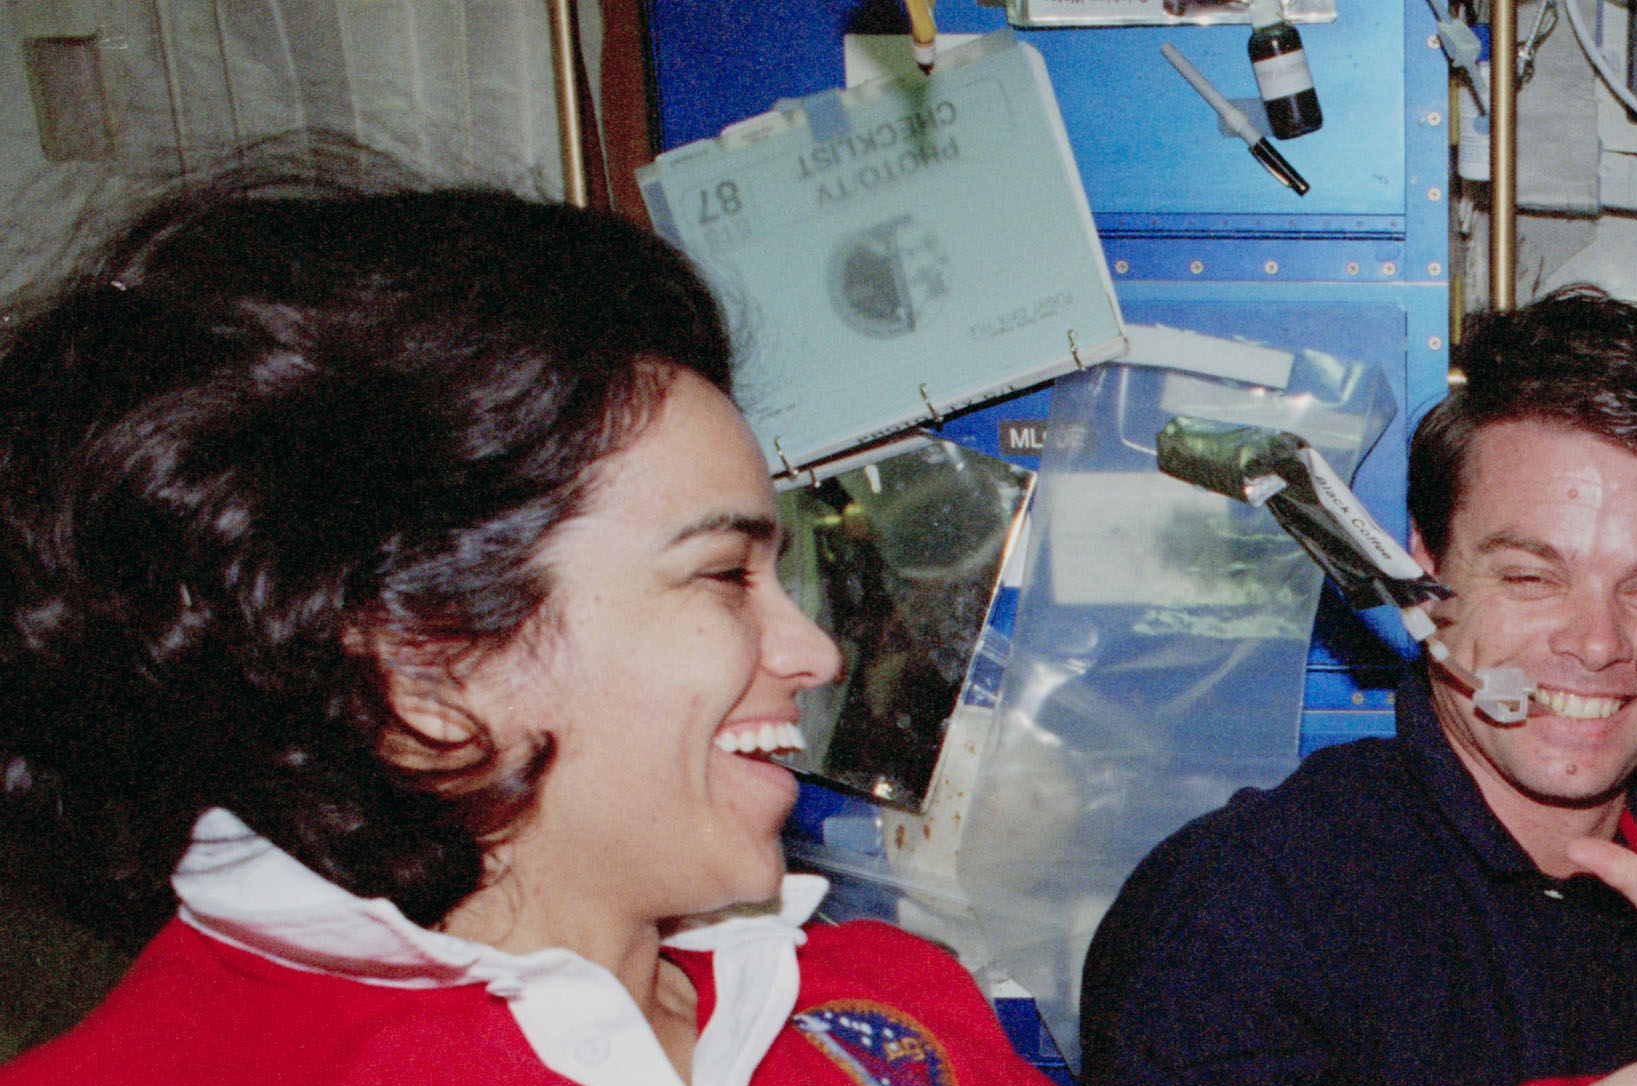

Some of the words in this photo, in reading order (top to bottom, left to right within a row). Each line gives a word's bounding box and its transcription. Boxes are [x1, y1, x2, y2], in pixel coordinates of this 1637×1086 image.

[797, 101, 957, 181] CHECKLIST
[698, 181, 742, 226] 87
[1312, 475, 1350, 515] Black
[1351, 517, 1393, 561] Coffee
